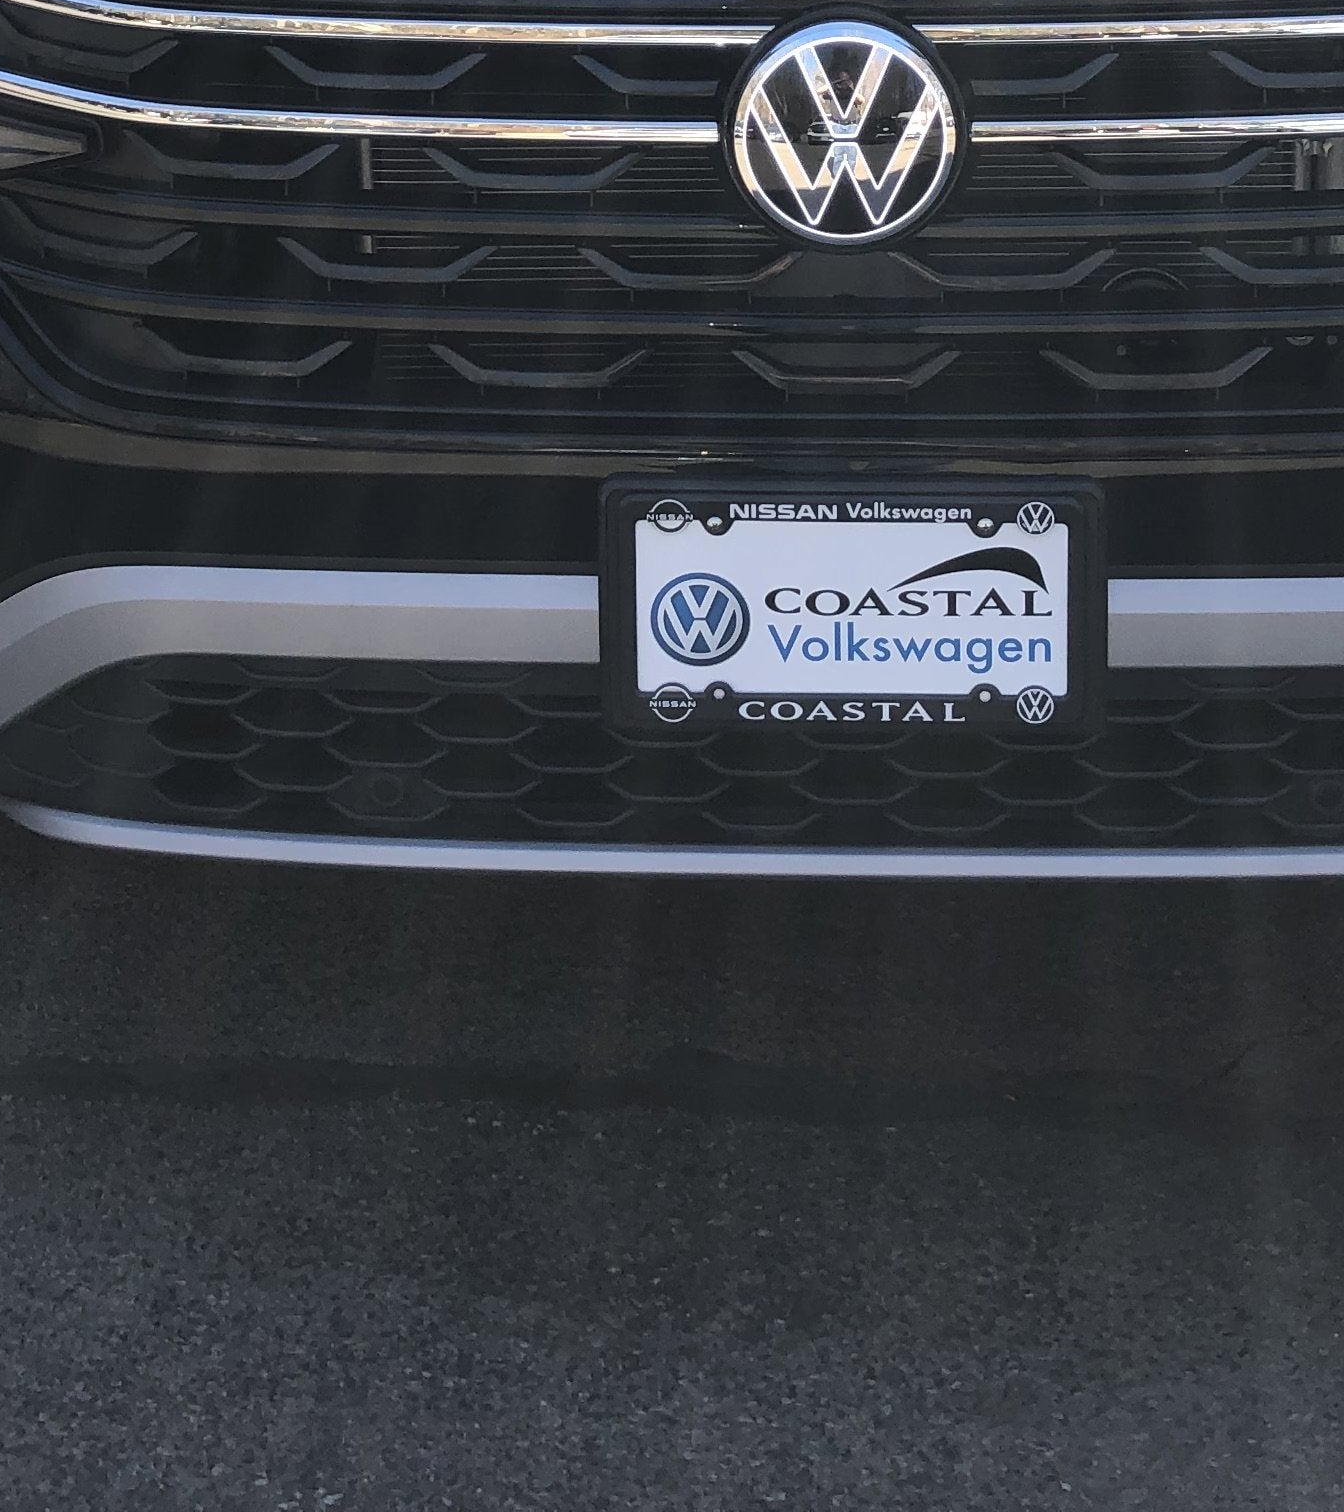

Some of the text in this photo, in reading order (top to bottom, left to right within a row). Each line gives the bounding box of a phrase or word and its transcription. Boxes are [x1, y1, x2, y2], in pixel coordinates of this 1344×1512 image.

[729, 502, 973, 523] NISSAN Volkswagen
[765, 588, 1052, 617] COASTAL
[768, 621, 1052, 674] Volkswagen
[649, 700, 696, 708] NISSAN
[739, 701, 965, 722] COASTAL
